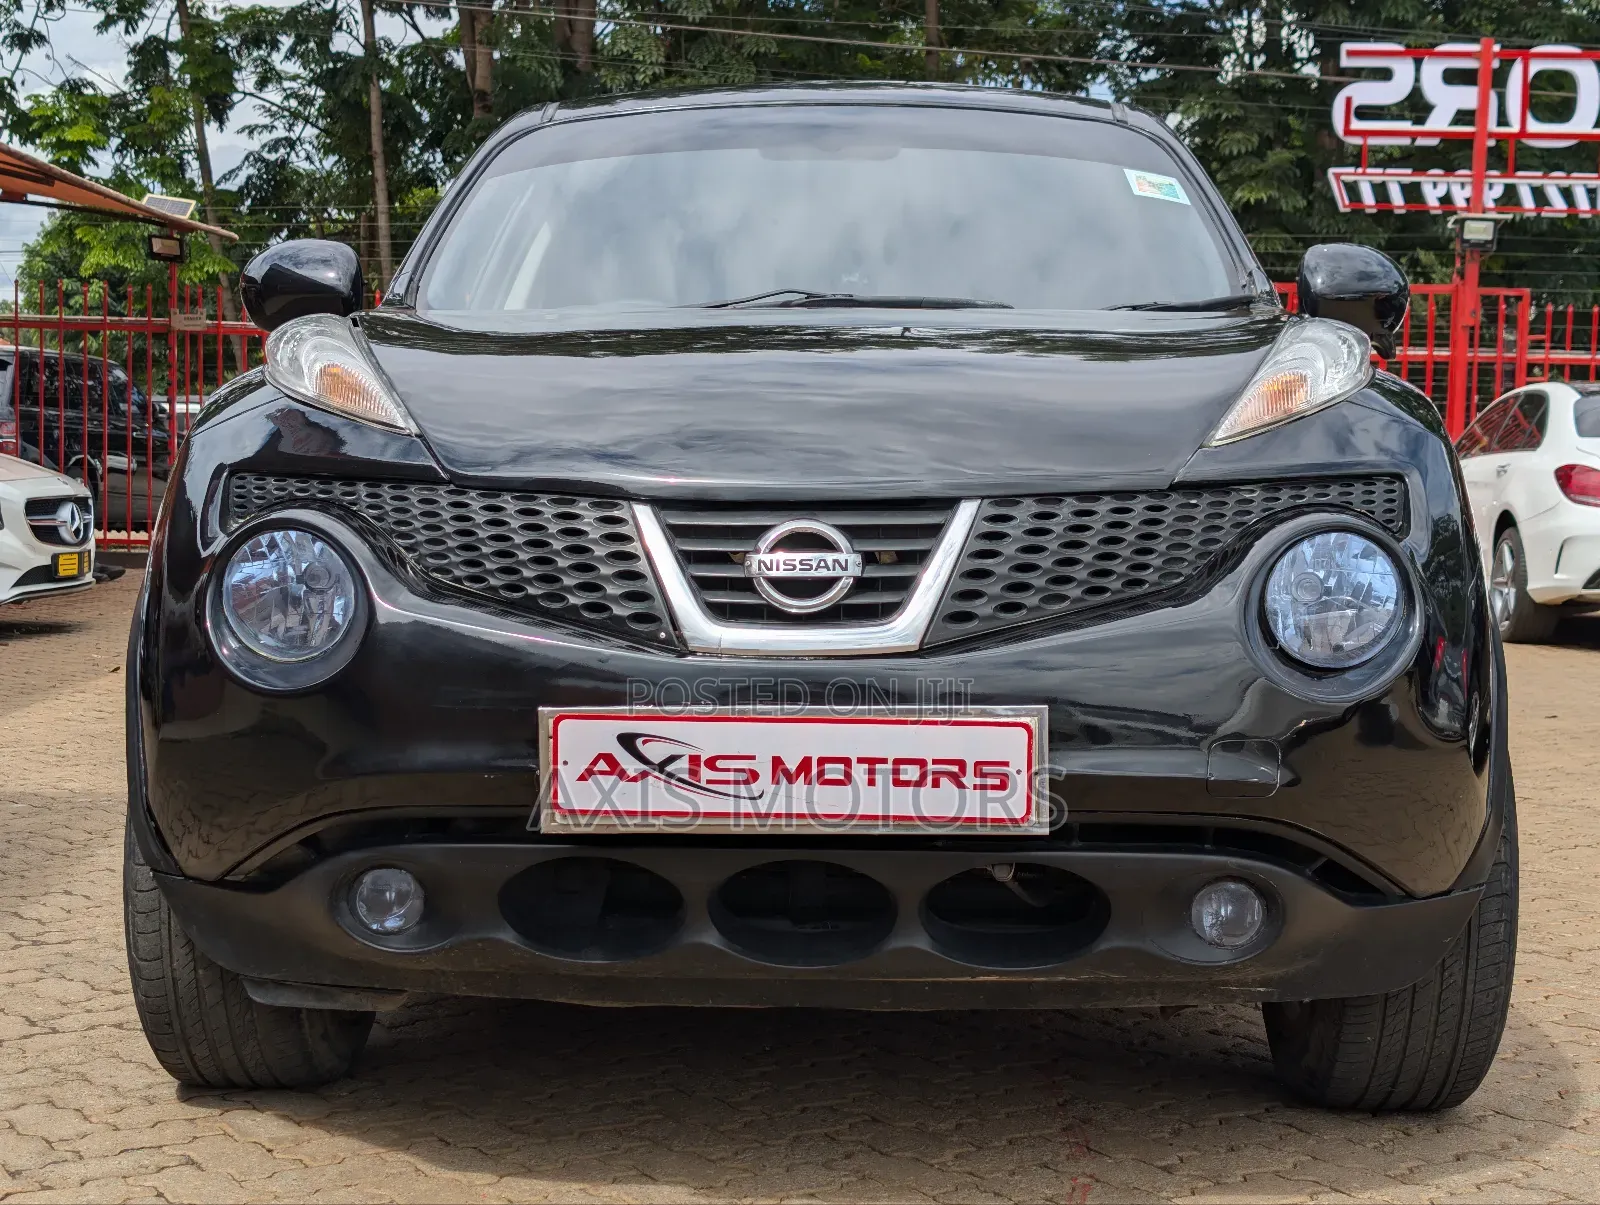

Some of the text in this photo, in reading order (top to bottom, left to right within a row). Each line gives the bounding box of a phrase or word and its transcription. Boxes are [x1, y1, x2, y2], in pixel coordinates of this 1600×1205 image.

[757, 558, 849, 572] NISSAN
[575, 748, 1010, 791] AXIS MOTORS
